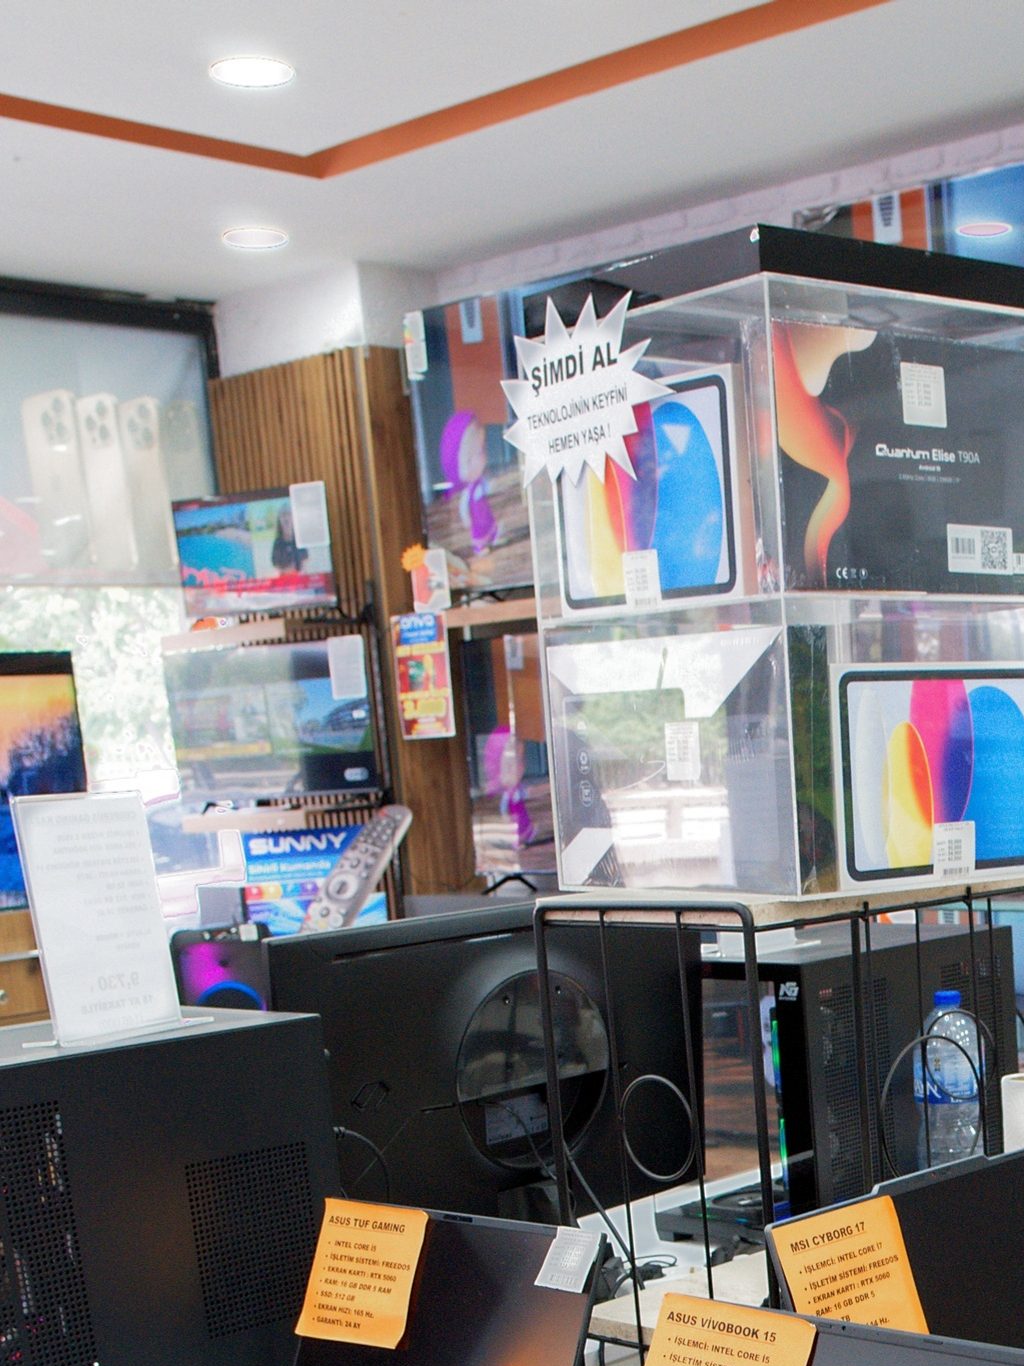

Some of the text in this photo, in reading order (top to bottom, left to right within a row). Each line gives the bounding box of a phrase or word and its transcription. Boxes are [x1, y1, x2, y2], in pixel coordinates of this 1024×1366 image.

[531, 342, 617, 397] ŞİMDİ AL
[528, 381, 628, 431] TEKNOLOJİNİN KEYFİNİ
[548, 433, 580, 454] HEMEN
[582, 425, 606, 446] YAŞA
[875, 443, 980, 464] Quantum Elise T90A
[248, 832, 347, 855] SUNNY
[329, 1216, 405, 1233] ASUS TUF GAMING
[354, 1243, 369, 1251] CORE
[790, 1221, 865, 1253] MSI CYBORG 17
[837, 1251, 857, 1262] INTEL
[858, 1244, 876, 1256] CORE
[327, 1266, 347, 1274] EKRAN
[348, 1269, 365, 1277] KARTI
[370, 1272, 380, 1280] RTX
[382, 1261, 410, 1271] FREEDOS
[809, 1274, 838, 1291] İŞLETİM
[868, 1254, 899, 1270] FREEDOS
[359, 1283, 371, 1291] DDR
[378, 1286, 392, 1294] RAM
[813, 1272, 890, 1304] EKRAN KARTI RTX 5060
[318, 1303, 337, 1311] EKRAN
[815, 1306, 832, 1317] RAM:
[834, 1302, 842, 1310] 16
[843, 1298, 853, 1306] GB
[854, 1293, 870, 1303] DDR
[667, 1311, 776, 1342] ASUS VİVOBOOK 15
[669, 1353, 702, 1366] İŞLETİM
[674, 1336, 709, 1351] İŞLEMCİ:
[711, 1345, 734, 1357] INTEL
[737, 1350, 760, 1361] CORE
